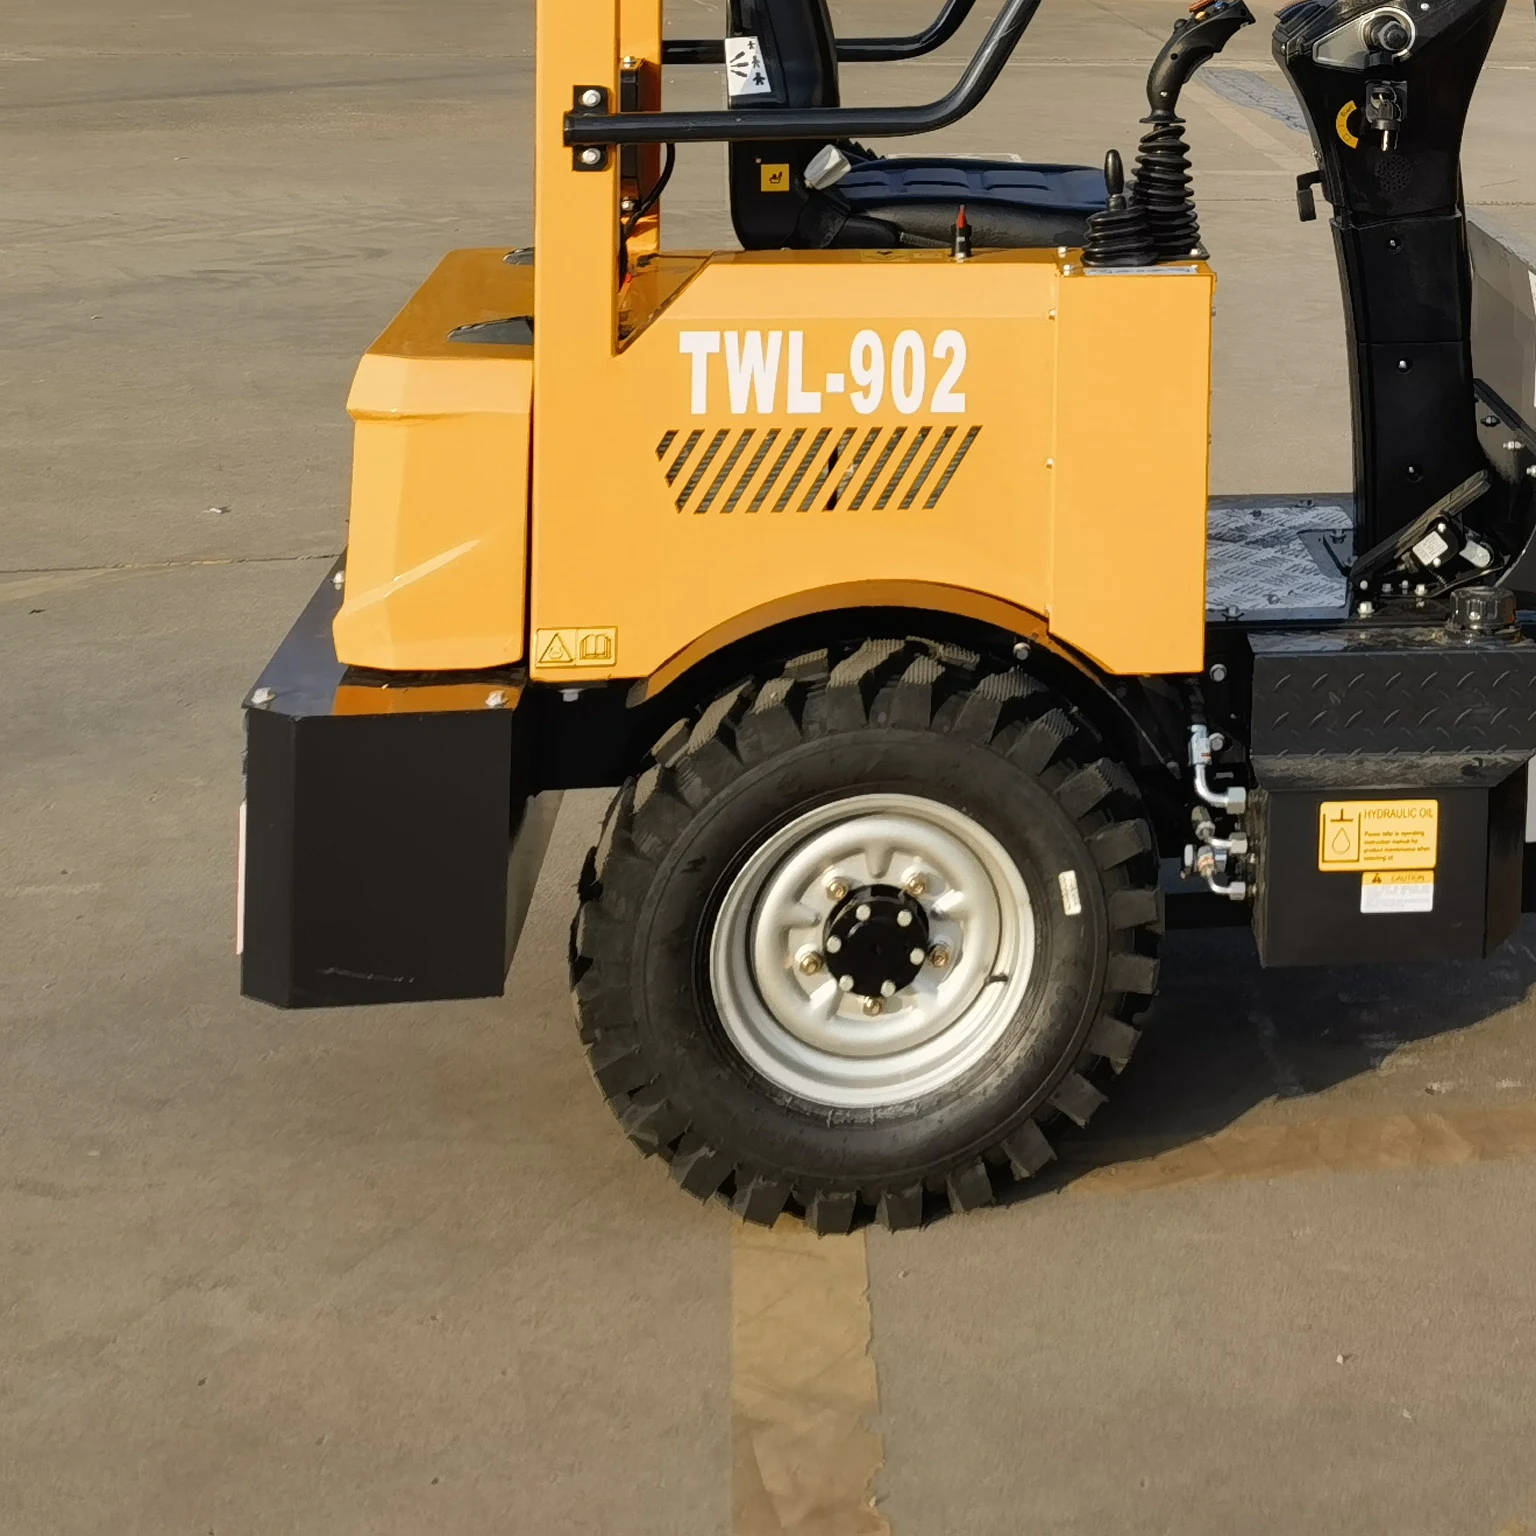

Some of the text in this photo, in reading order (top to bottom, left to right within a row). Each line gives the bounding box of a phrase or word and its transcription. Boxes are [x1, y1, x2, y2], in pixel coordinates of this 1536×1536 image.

[679, 329, 967, 414] TWL-902
[1364, 807, 1434, 819] HYDRAULIC OIL
